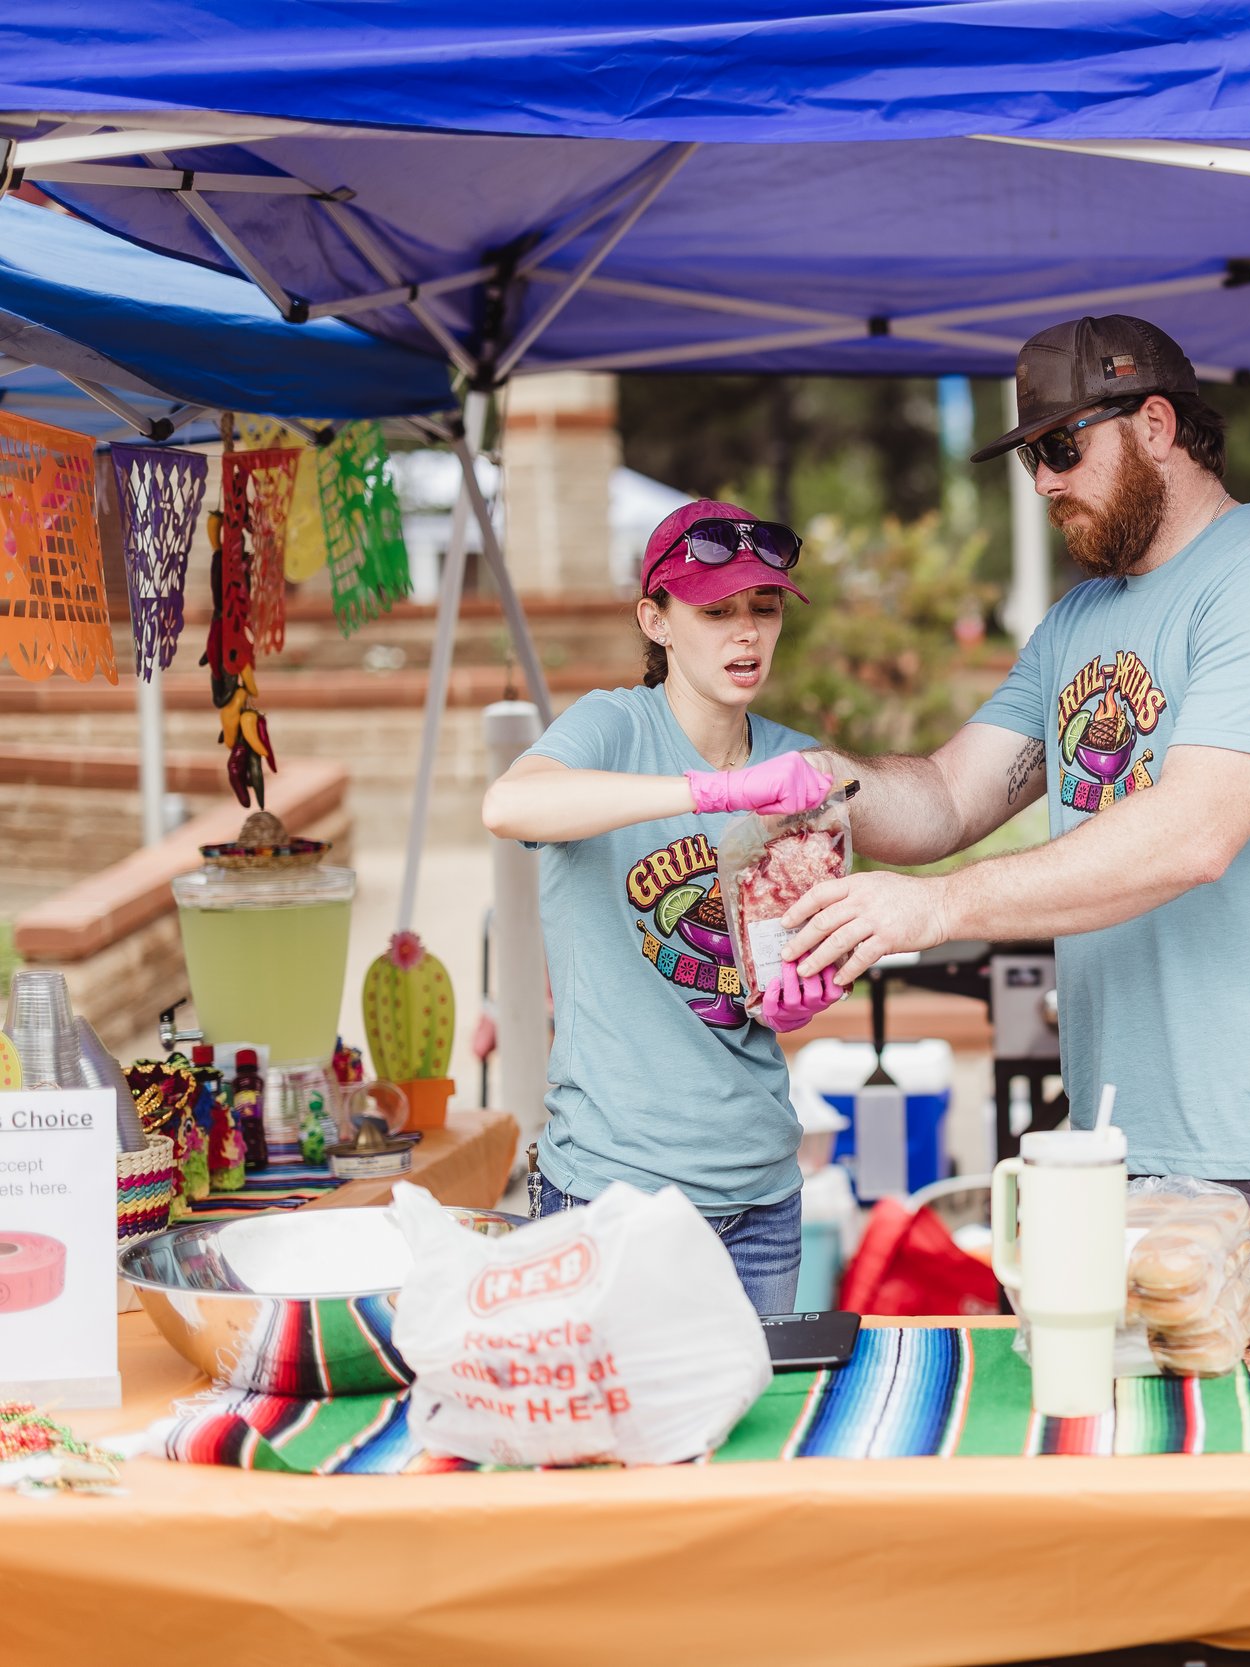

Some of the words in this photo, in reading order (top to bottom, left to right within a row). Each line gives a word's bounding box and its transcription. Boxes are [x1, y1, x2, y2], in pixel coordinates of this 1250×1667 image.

[11, 1109, 94, 1129] Choice
[29, 1181, 72, 1196] here.
[463, 1318, 593, 1356] Recycle
[509, 1359, 576, 1391] bag
[587, 1351, 619, 1383] at
[525, 1386, 632, 1424] H-E-B
